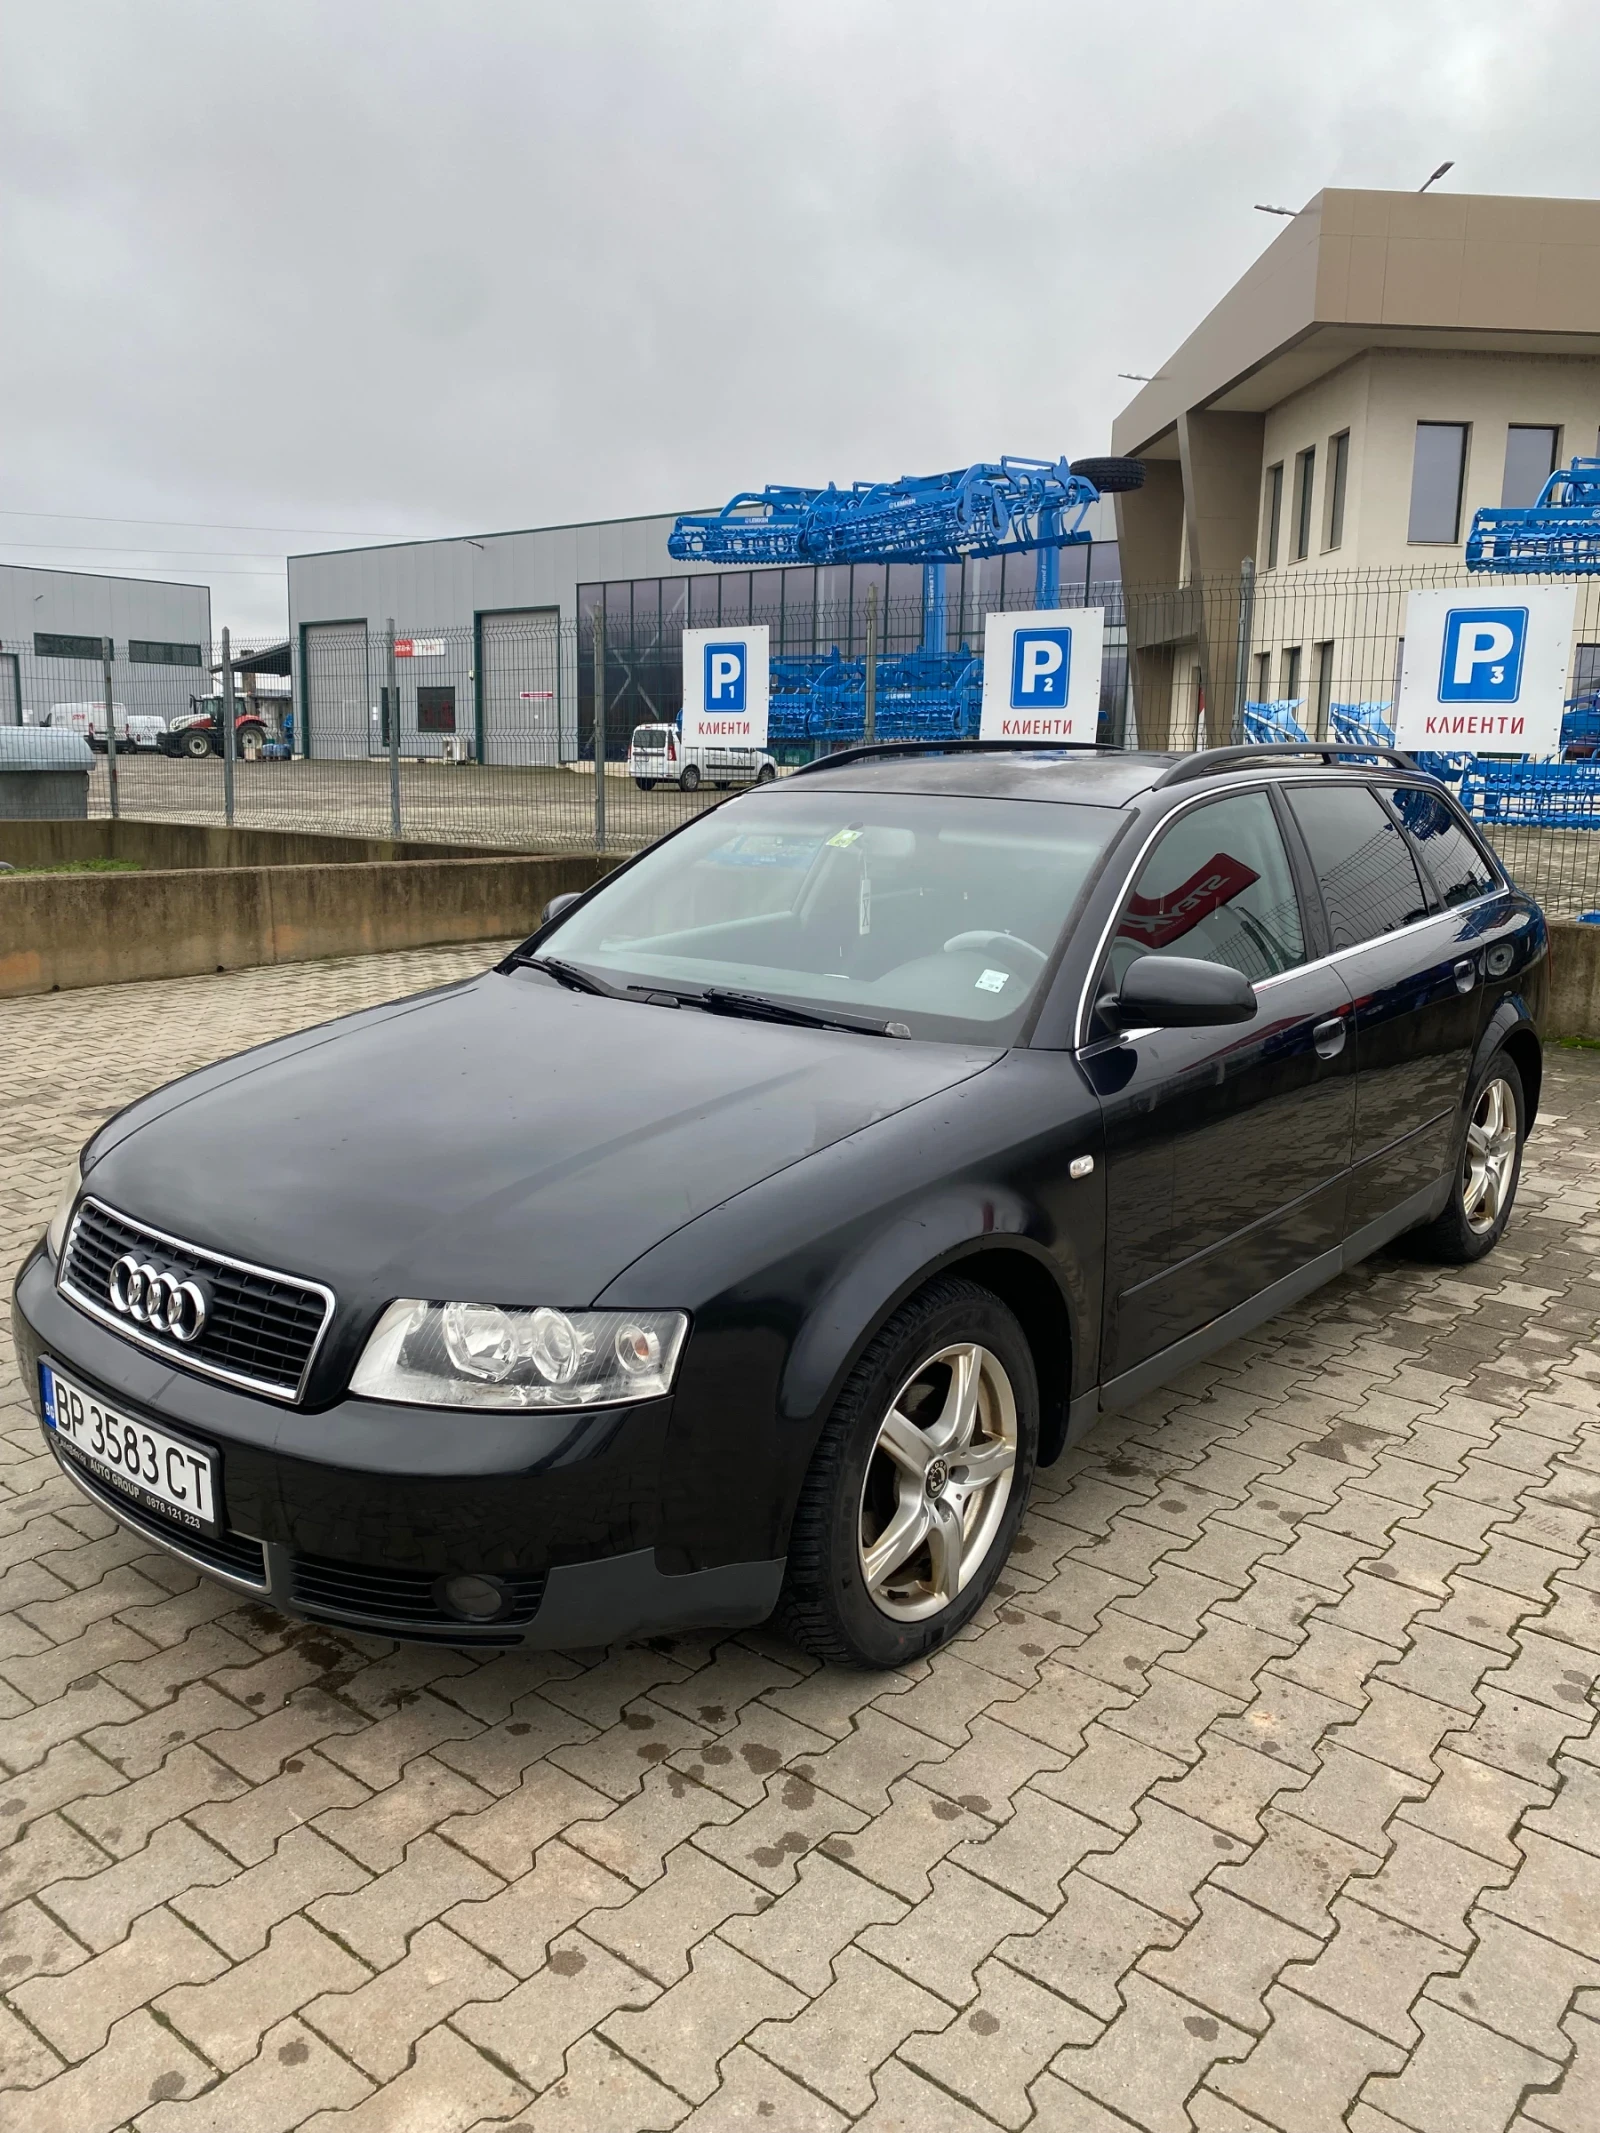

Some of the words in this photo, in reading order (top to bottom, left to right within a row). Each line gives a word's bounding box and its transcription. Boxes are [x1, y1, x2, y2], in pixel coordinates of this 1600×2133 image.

[698, 721, 751, 735] КЛИЕНТИ
[1002, 719, 1073, 735] КЛИЕНТИ
[1425, 716, 1525, 735] КЛИЕНТИ
[44, 1401, 55, 1420] BG
[55, 1379, 84, 1438] BP
[90, 1405, 159, 1485] 3583
[165, 1446, 207, 1510] CT
[90, 1458, 111, 1481] AUTO
[111, 1473, 140, 1498] GROUP
[146, 1495, 166, 1513] 0878
[167, 1505, 182, 1520] 121
[184, 1513, 201, 1529] 223
